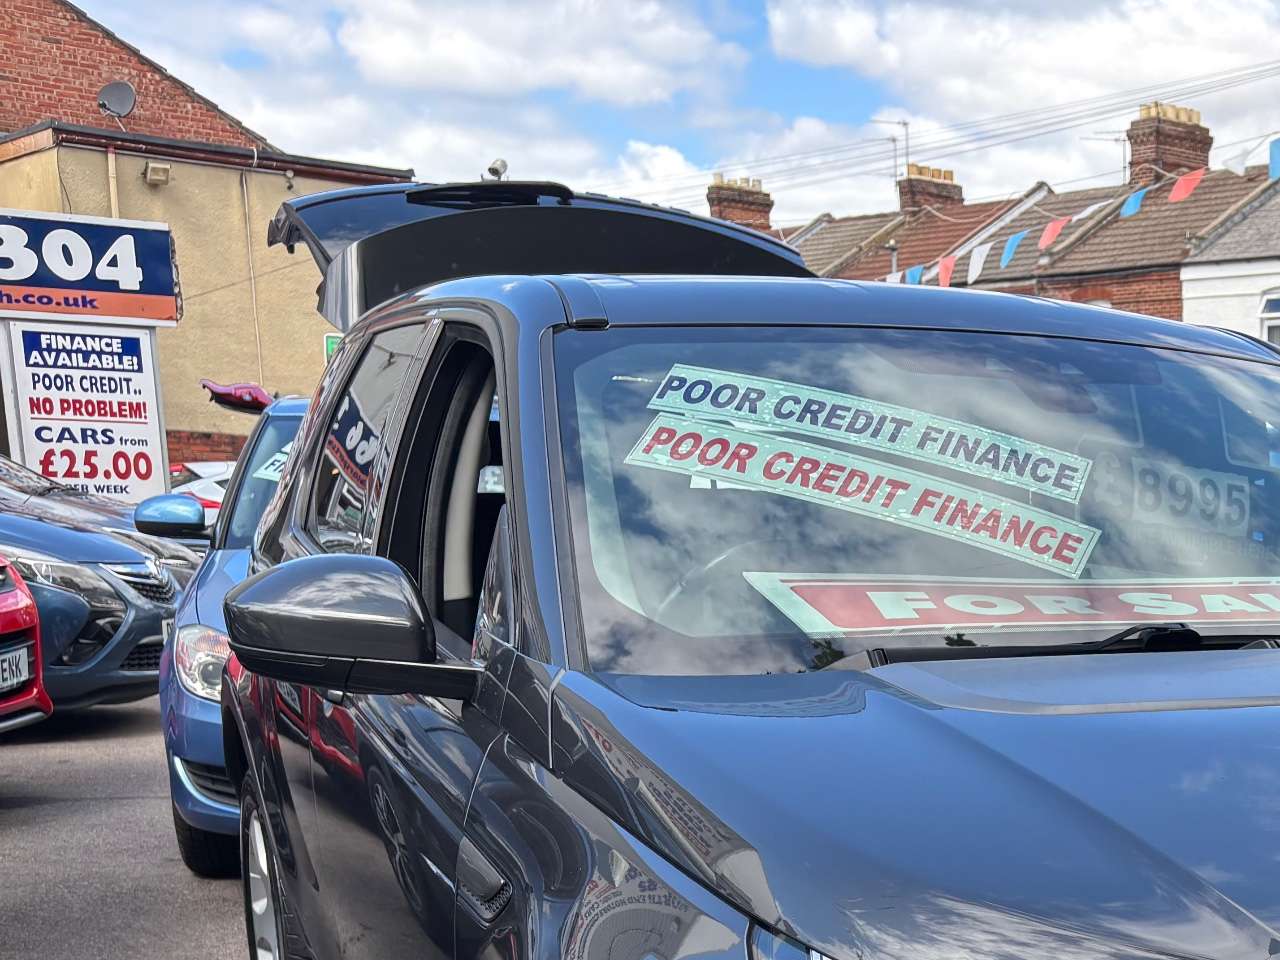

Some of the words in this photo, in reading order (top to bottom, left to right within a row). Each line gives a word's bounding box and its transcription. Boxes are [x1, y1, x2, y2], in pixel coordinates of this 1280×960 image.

[40, 333, 123, 354] FINANCE
[28, 350, 139, 371] AVAILABLE!
[31, 372, 76, 393] POOR
[28, 396, 55, 416] NO
[59, 398, 148, 420] PROBLEM!
[34, 425, 115, 445] CARS
[119, 435, 149, 447] from
[655, 374, 767, 415] POOR
[773, 394, 914, 444] CREDIT
[916, 425, 1080, 493] FINANCE
[38, 447, 153, 481] £25.00
[93, 484, 130, 495] WEEK
[643, 426, 759, 474] POOR
[761, 450, 912, 509] CREDIT
[910, 487, 1085, 566] FINANCE
[866, 591, 1105, 620] FOR
[0, 653, 22, 683] ENK
